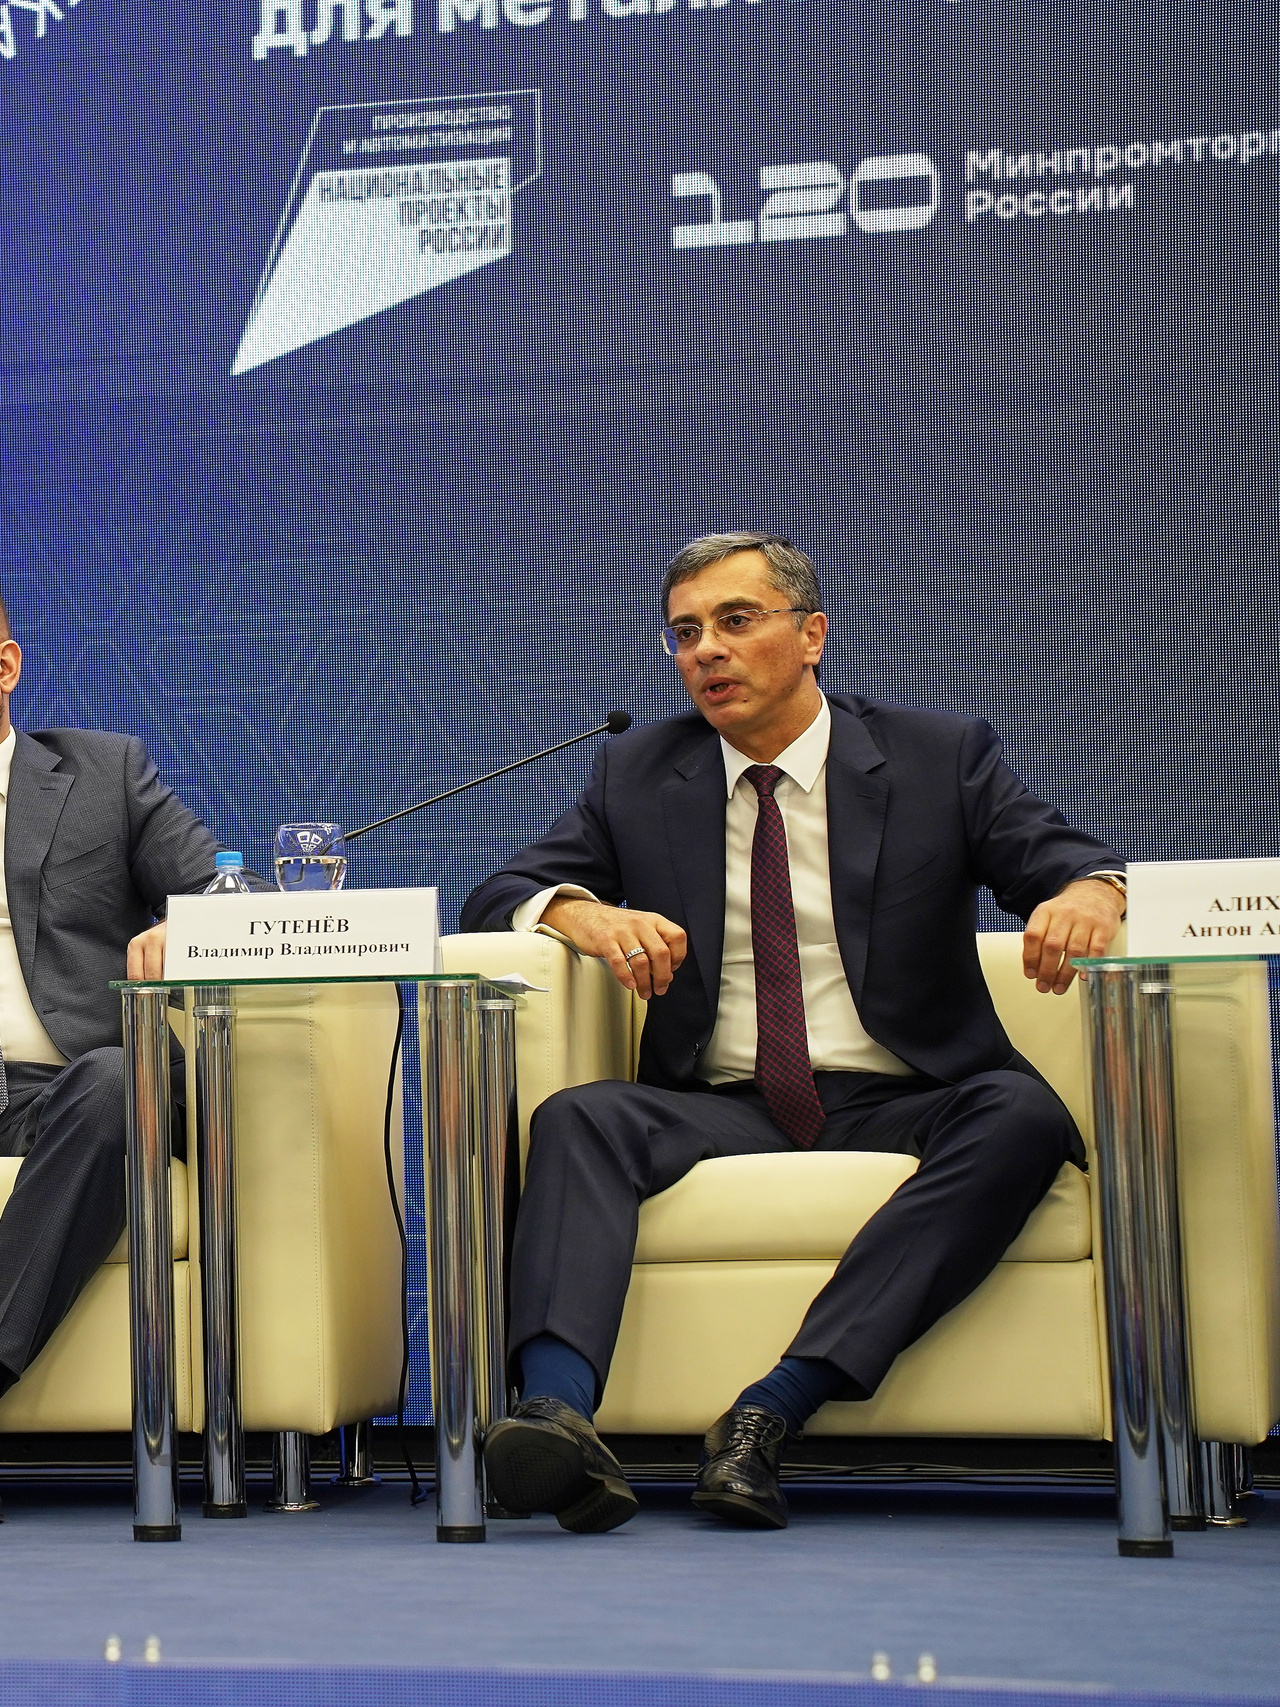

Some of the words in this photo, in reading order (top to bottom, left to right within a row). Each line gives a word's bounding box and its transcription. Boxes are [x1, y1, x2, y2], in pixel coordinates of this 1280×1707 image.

[318, 163, 505, 203] НАЦИОНАЛЬНЫЕ
[398, 194, 506, 227] ПРОЕКТЫ
[672, 152, 941, 249] 120
[965, 182, 1135, 224] России
[419, 223, 506, 255] РОССИИ
[1208, 896, 1280, 912] АЛИХ
[249, 916, 350, 936] ГУТЕНЁВ
[1182, 923, 1251, 938] Антон
[1260, 921, 1280, 936] А
[187, 944, 274, 960] Владимир
[280, 942, 410, 957] Владимирович
